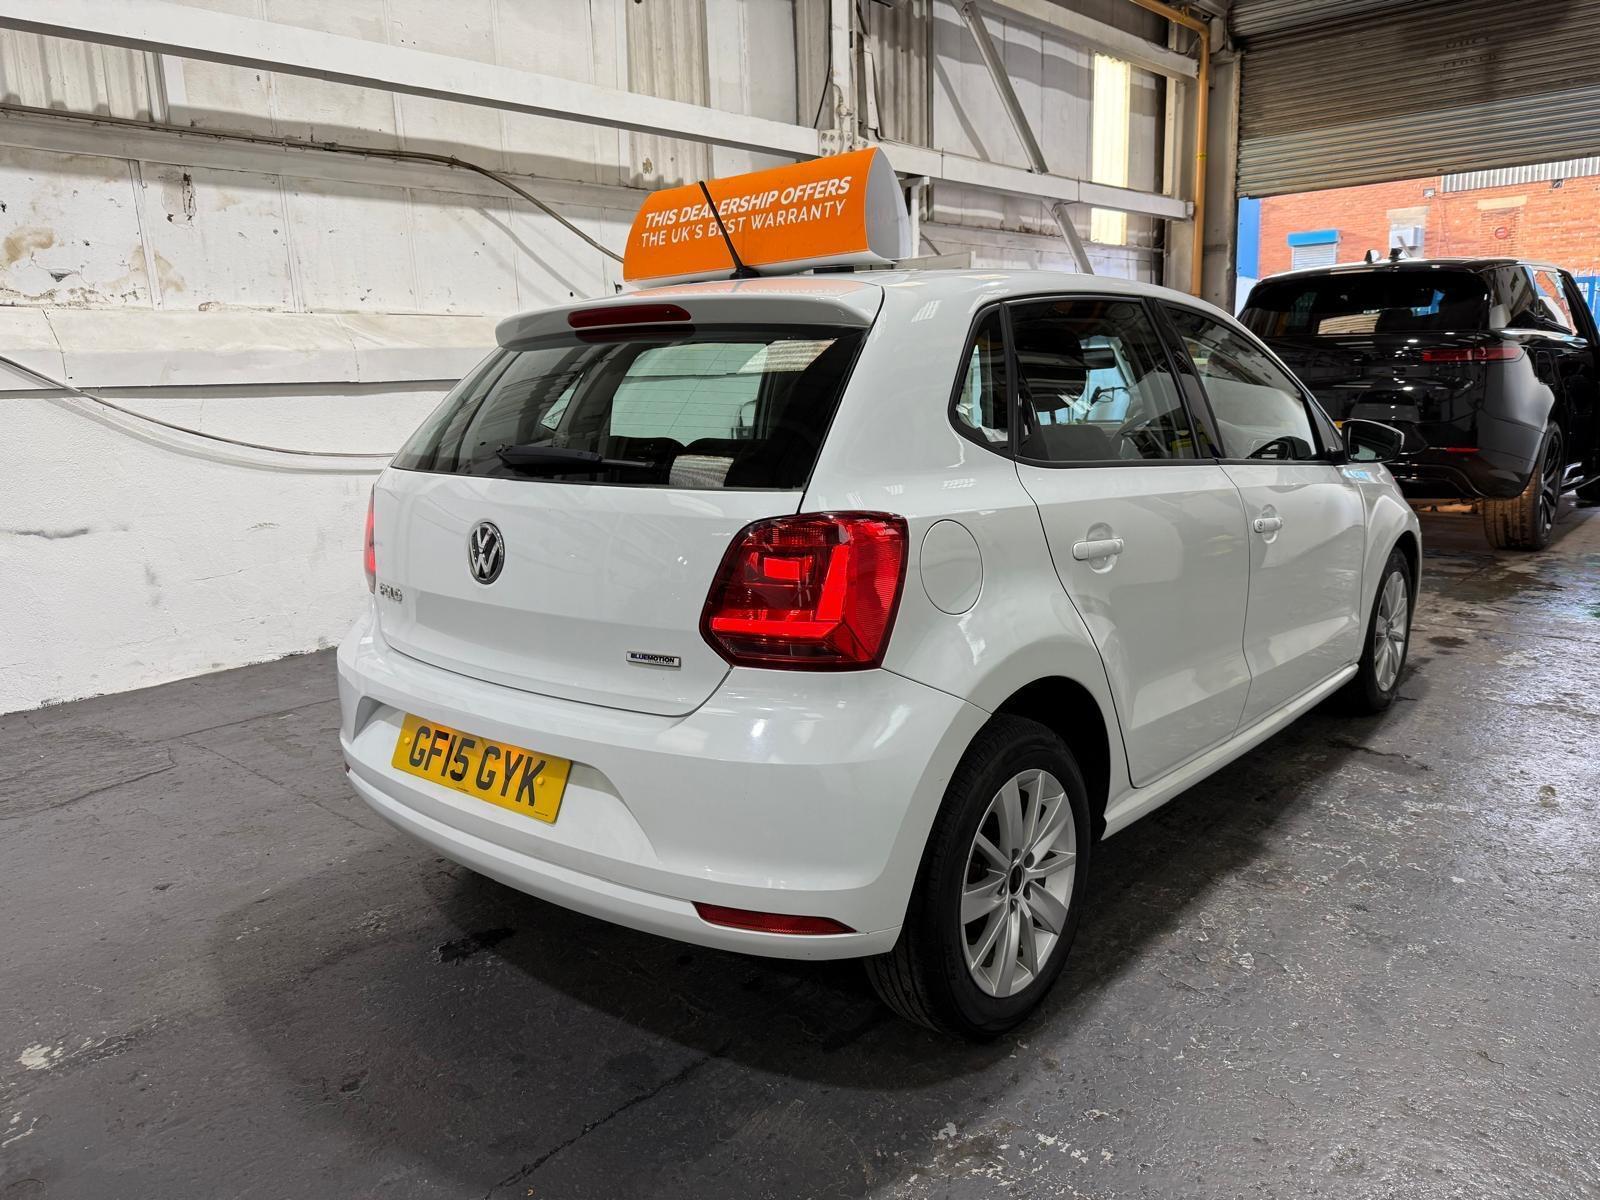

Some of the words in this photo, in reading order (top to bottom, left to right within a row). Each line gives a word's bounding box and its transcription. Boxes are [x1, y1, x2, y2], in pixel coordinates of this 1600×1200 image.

[641, 230, 666, 248] THE
[671, 223, 703, 243] UK'S
[751, 199, 846, 229] WARRANTY
[645, 207, 678, 229] THIS
[781, 176, 852, 201] OFFERS
[630, 652, 675, 663] BLUEMOTION
[409, 725, 475, 782] GF15
[475, 745, 546, 807] GYK
